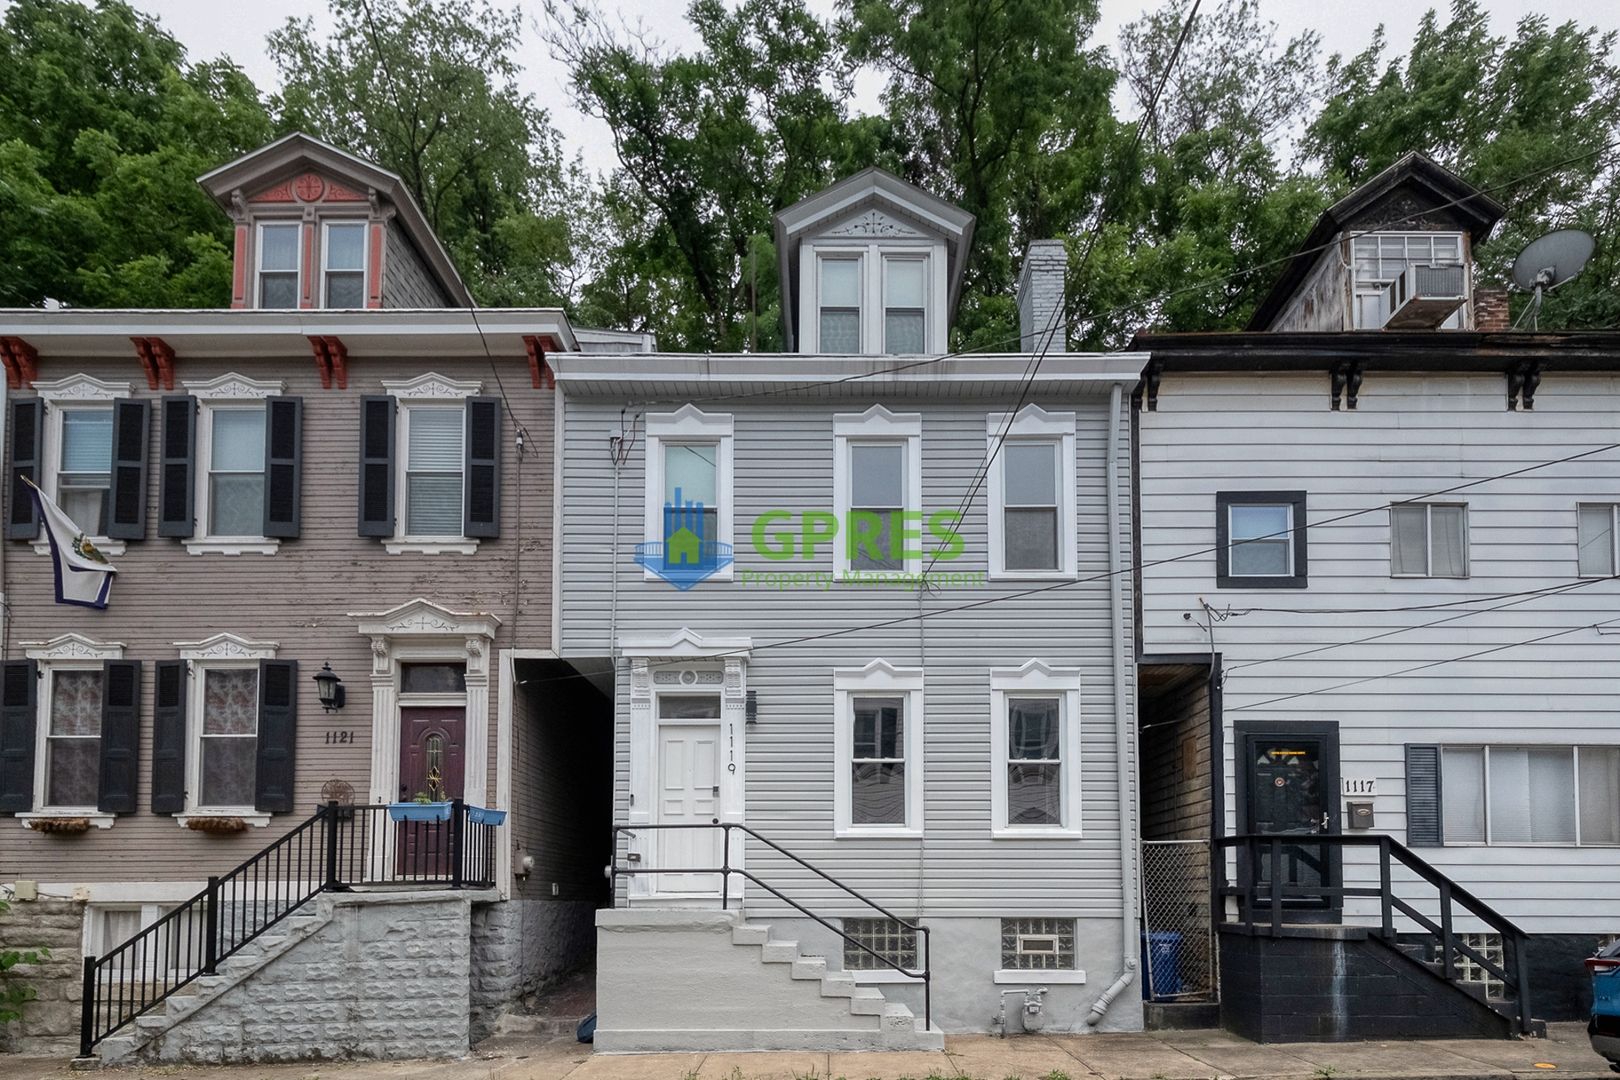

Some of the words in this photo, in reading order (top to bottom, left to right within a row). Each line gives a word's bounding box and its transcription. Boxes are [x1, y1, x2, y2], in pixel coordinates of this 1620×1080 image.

[325, 731, 354, 744] 1121
[727, 723, 736, 775] 1119
[1346, 780, 1374, 793] 1117
